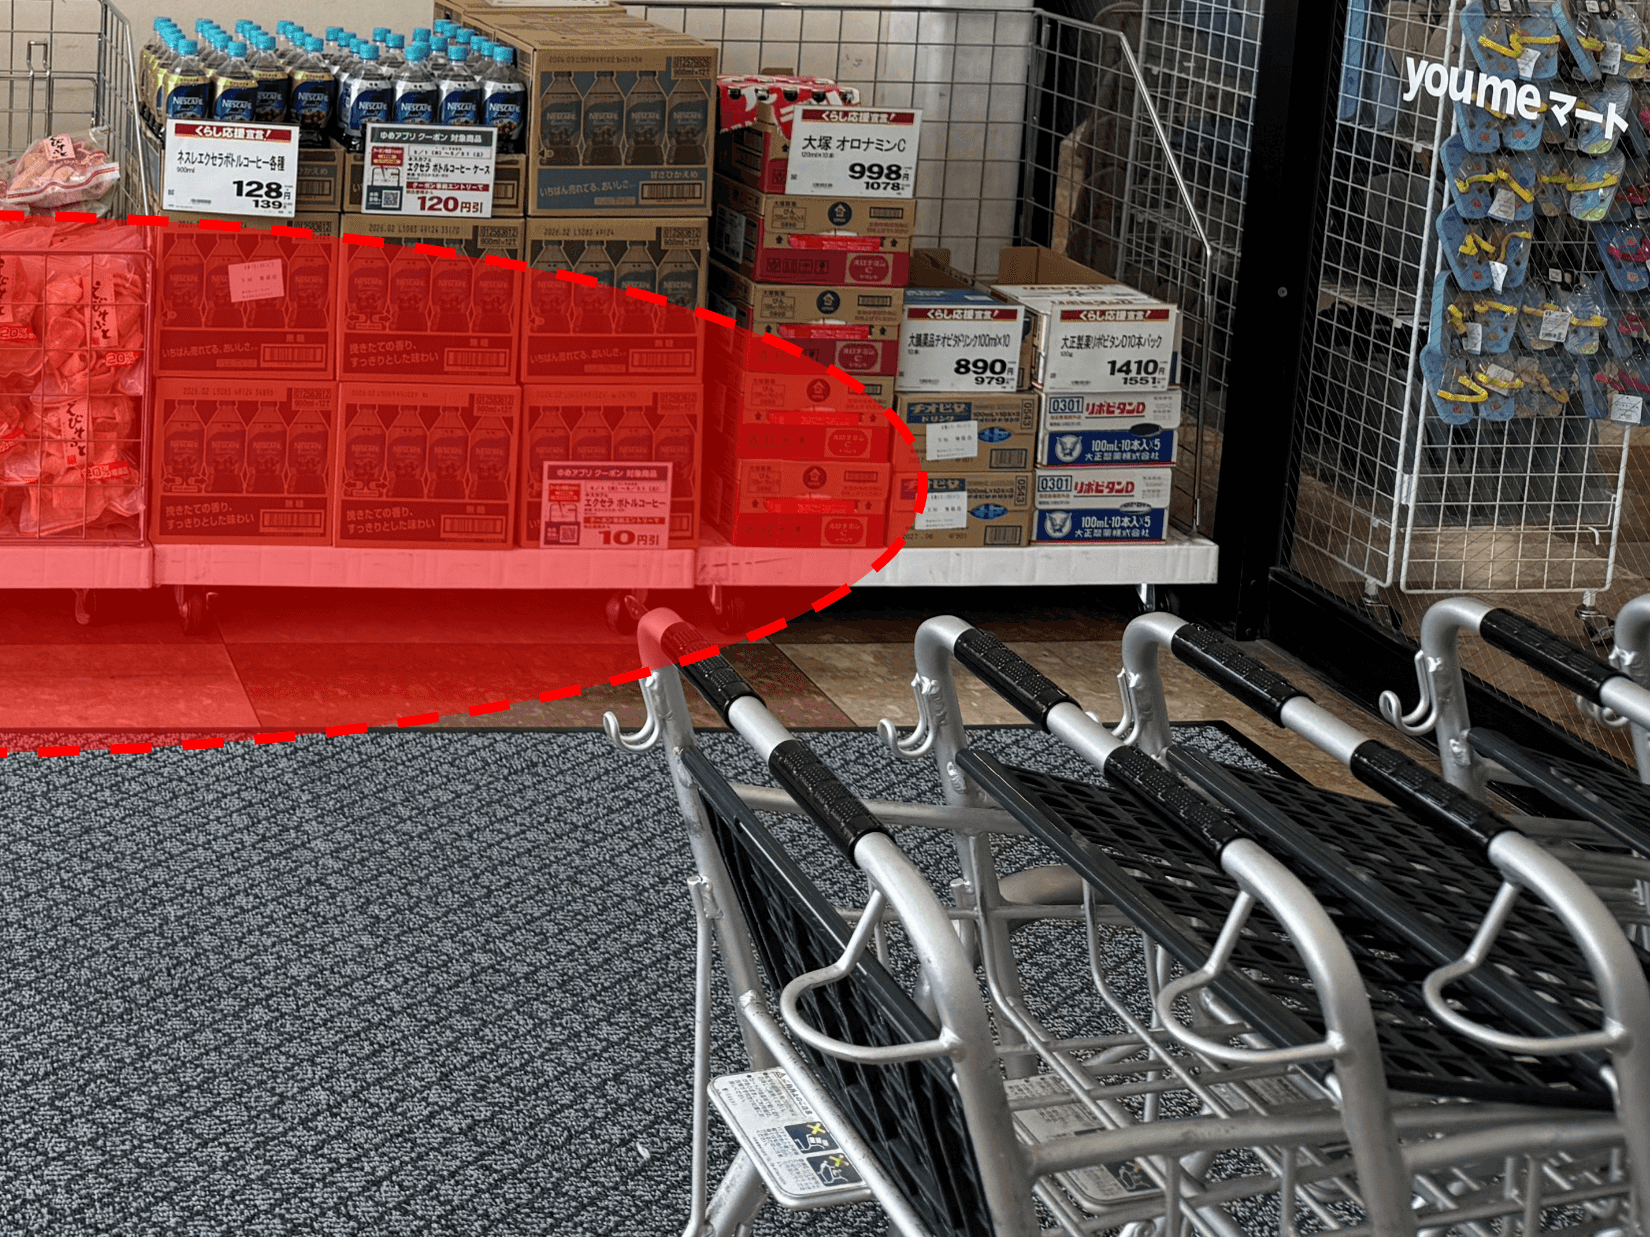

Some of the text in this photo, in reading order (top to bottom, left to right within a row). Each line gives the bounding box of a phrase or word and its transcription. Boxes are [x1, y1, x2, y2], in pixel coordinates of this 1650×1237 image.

[1402, 56, 1629, 140] youme マート
[802, 135, 906, 152] 大塚 オロナミンC
[407, 162, 430, 172] エクセラ
[473, 165, 491, 174] ケース
[848, 163, 902, 180] 998
[233, 180, 283, 199] 128
[864, 181, 900, 191] 1078
[252, 200, 282, 209] 139
[954, 358, 1007, 375] 890
[1107, 359, 1159, 376] 1410
[974, 376, 1006, 385] 979
[1122, 376, 1156, 385] 1551
[1052, 400, 1081, 412] 0301
[1086, 402, 1146, 415] リポビタンD
[1041, 478, 1135, 494] 0301 リポビタンD
